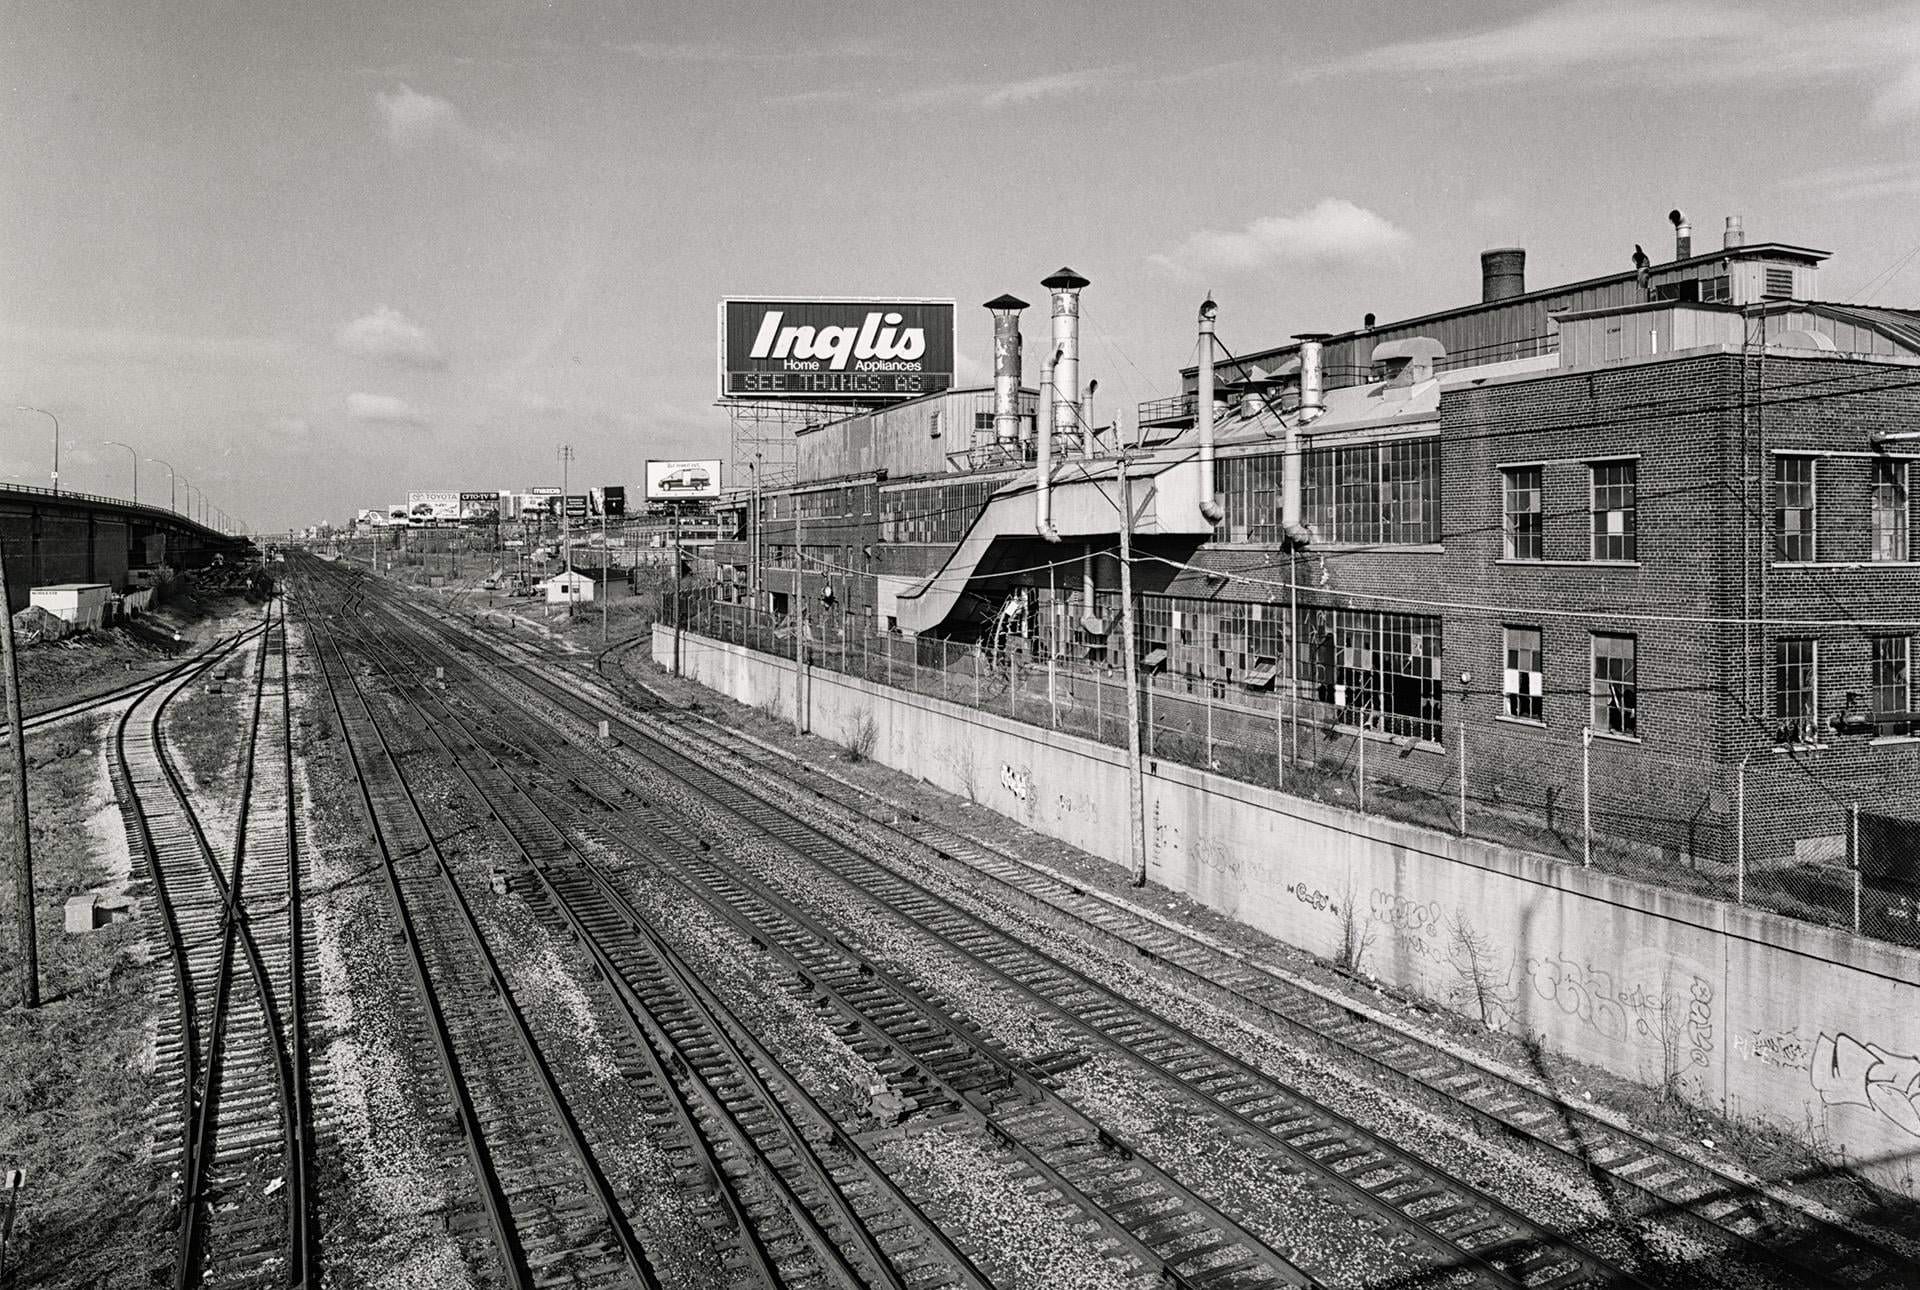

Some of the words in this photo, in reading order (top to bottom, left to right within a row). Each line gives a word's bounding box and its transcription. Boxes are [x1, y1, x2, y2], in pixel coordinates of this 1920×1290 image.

[749, 310, 927, 370] Inglis
[783, 359, 820, 371] Home
[855, 360, 922, 373] Appliances
[744, 374, 785, 391] SEE
[800, 374, 881, 391] THINGS
[895, 375, 922, 391] AS
